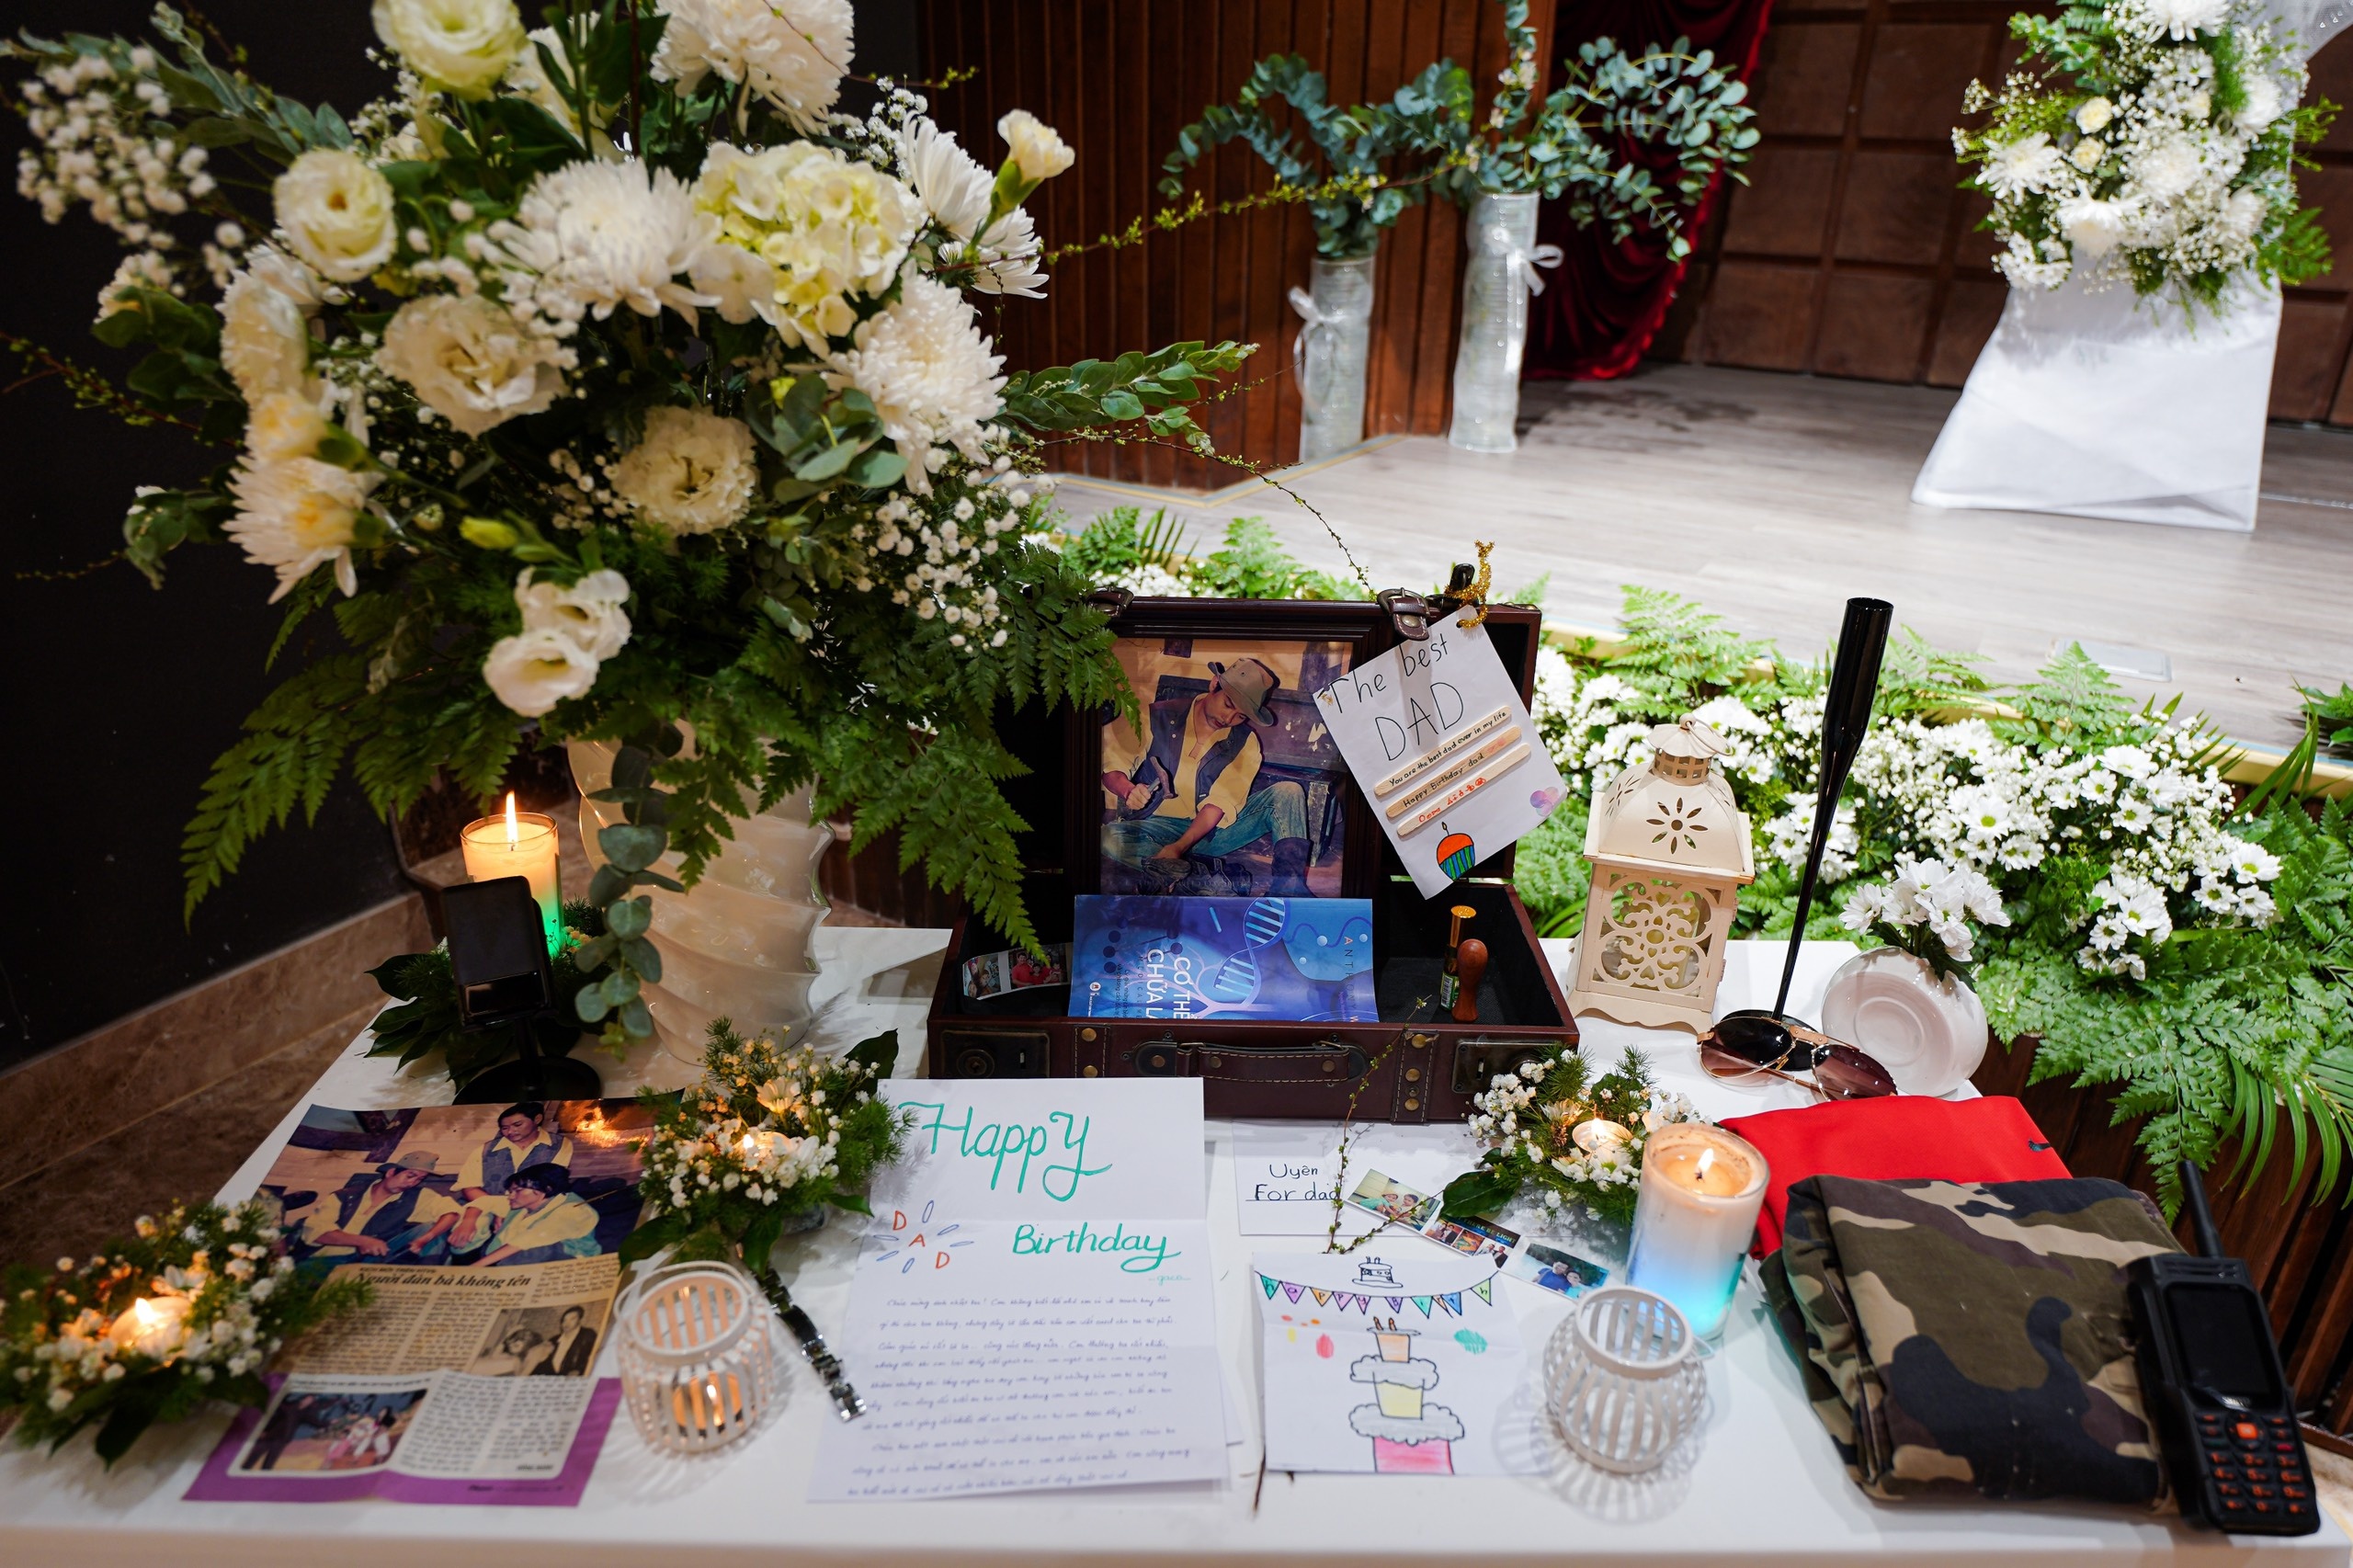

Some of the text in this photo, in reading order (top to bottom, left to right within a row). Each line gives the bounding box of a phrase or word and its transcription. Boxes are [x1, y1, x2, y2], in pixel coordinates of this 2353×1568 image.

[1317, 633, 1449, 714] The best
[1375, 682, 1464, 761] DAD
[1389, 778, 1403, 787] You
[1404, 767, 1416, 779] are
[1417, 761, 1428, 770] the
[1427, 750, 1442, 764] best
[1443, 742, 1457, 754] dad
[1458, 733, 1472, 744] ever
[1473, 725, 1482, 733] in
[1483, 721, 1493, 731] my
[1404, 790, 1428, 808] Happy
[1430, 767, 1463, 790] Birthday
[1468, 753, 1484, 767] dad
[1136, 955, 1144, 1004] MEDICAL
[1145, 949, 1168, 1004] CHỮA
[1173, 956, 1192, 986] CƠ
[898, 1100, 1113, 1202] Happy
[1269, 1163, 1318, 1179] Uyên
[1255, 1181, 1341, 1201] For dad
[1012, 1221, 1182, 1273] Birthday
[1496, 1232, 1517, 1244] LIGHT
[402, 1274, 434, 1285] đàn
[434, 1275, 456, 1286] bà
[457, 1275, 506, 1289] không
[506, 1275, 532, 1286] tên
